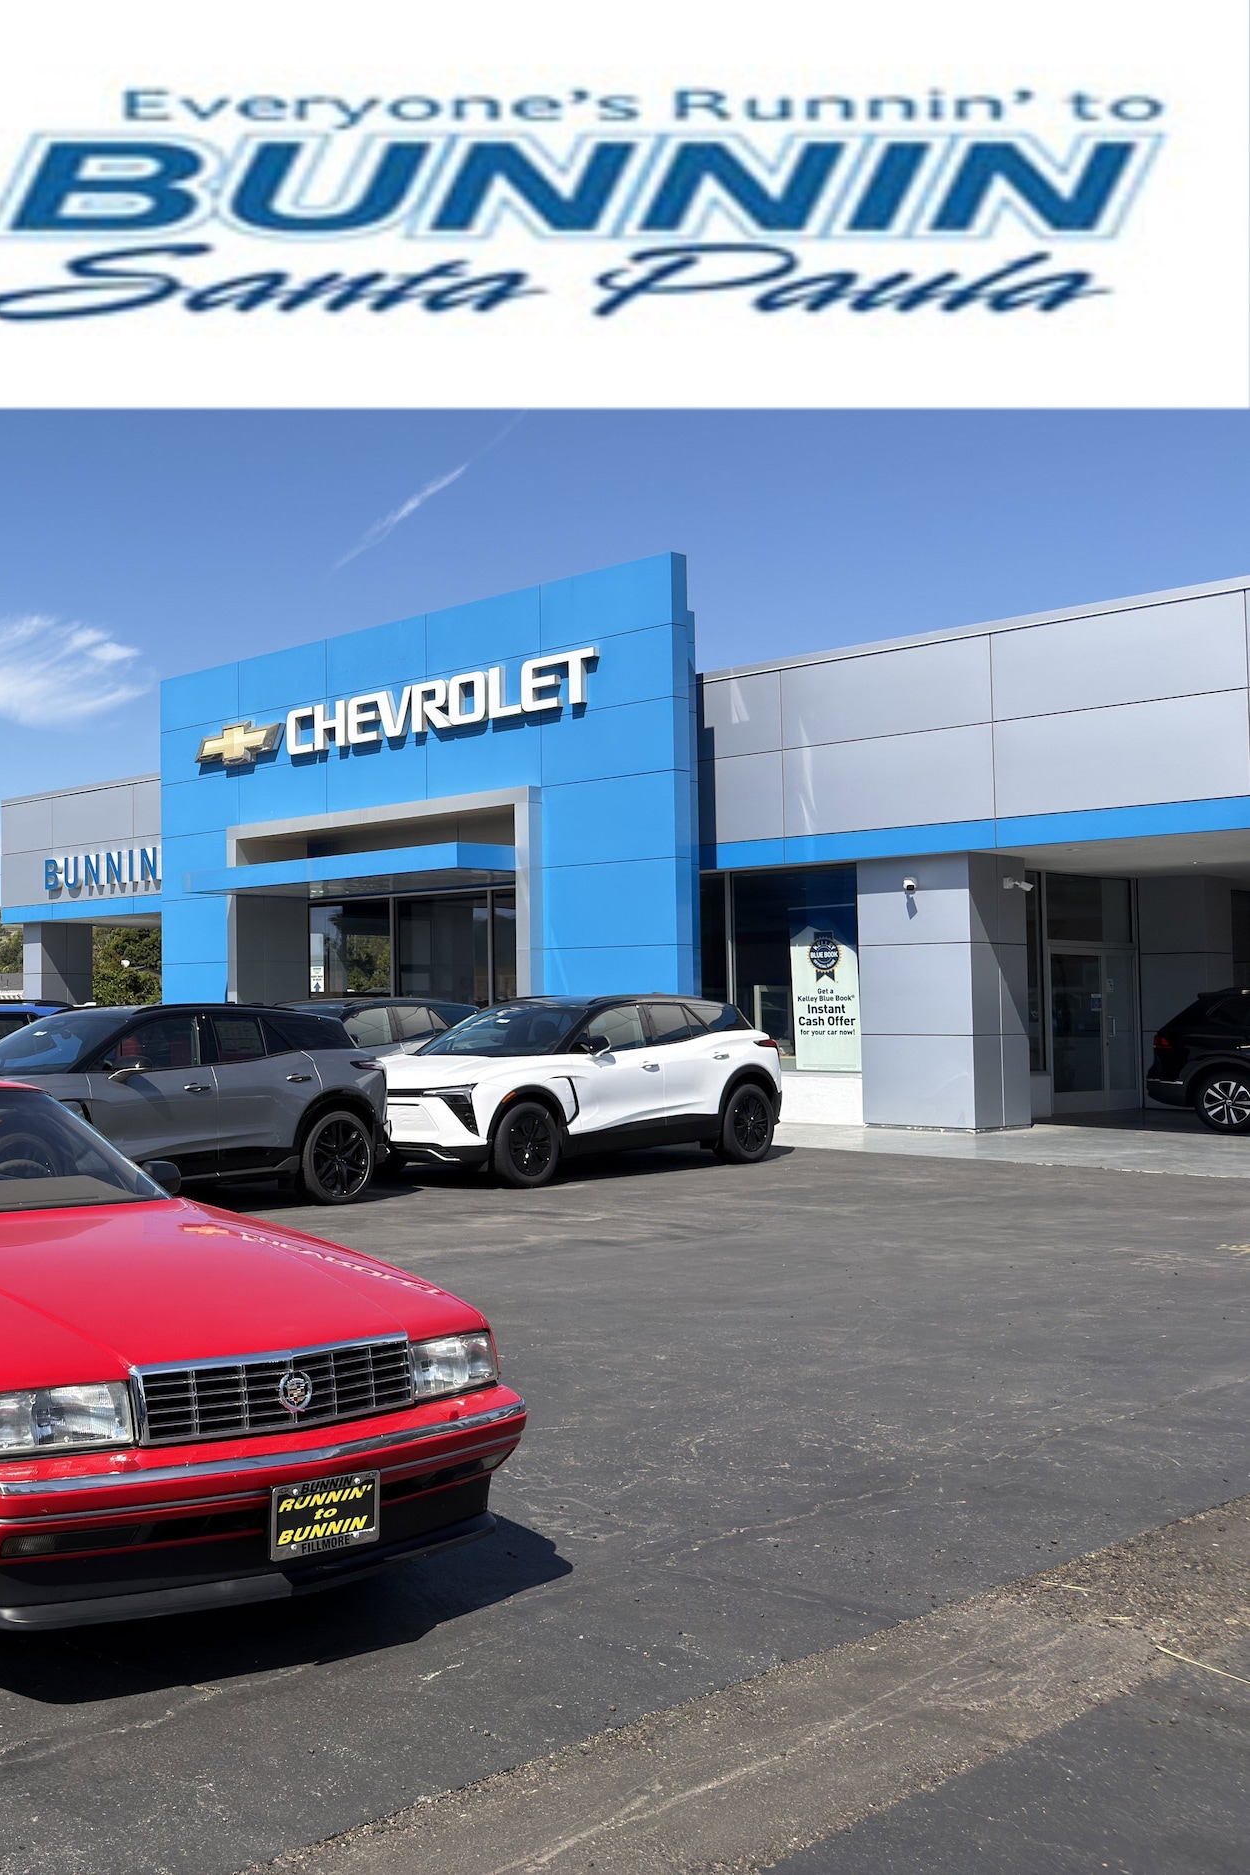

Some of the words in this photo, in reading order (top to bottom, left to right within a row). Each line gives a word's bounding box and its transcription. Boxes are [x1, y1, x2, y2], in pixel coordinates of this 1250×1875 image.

[286, 647, 599, 756] CHEVROLET
[44, 847, 158, 891] BUNNIN
[810, 951, 824, 959] BLUE
[797, 995, 818, 1003] Kelley
[807, 1004, 846, 1014] Instant
[798, 1016, 825, 1026] Cash
[827, 1016, 856, 1026] Offer
[301, 1476, 353, 1494] BUNNIN
[313, 1508, 338, 1520] to
[276, 1515, 368, 1546] BUNNIN
[301, 1535, 350, 1554] FILLMORE
